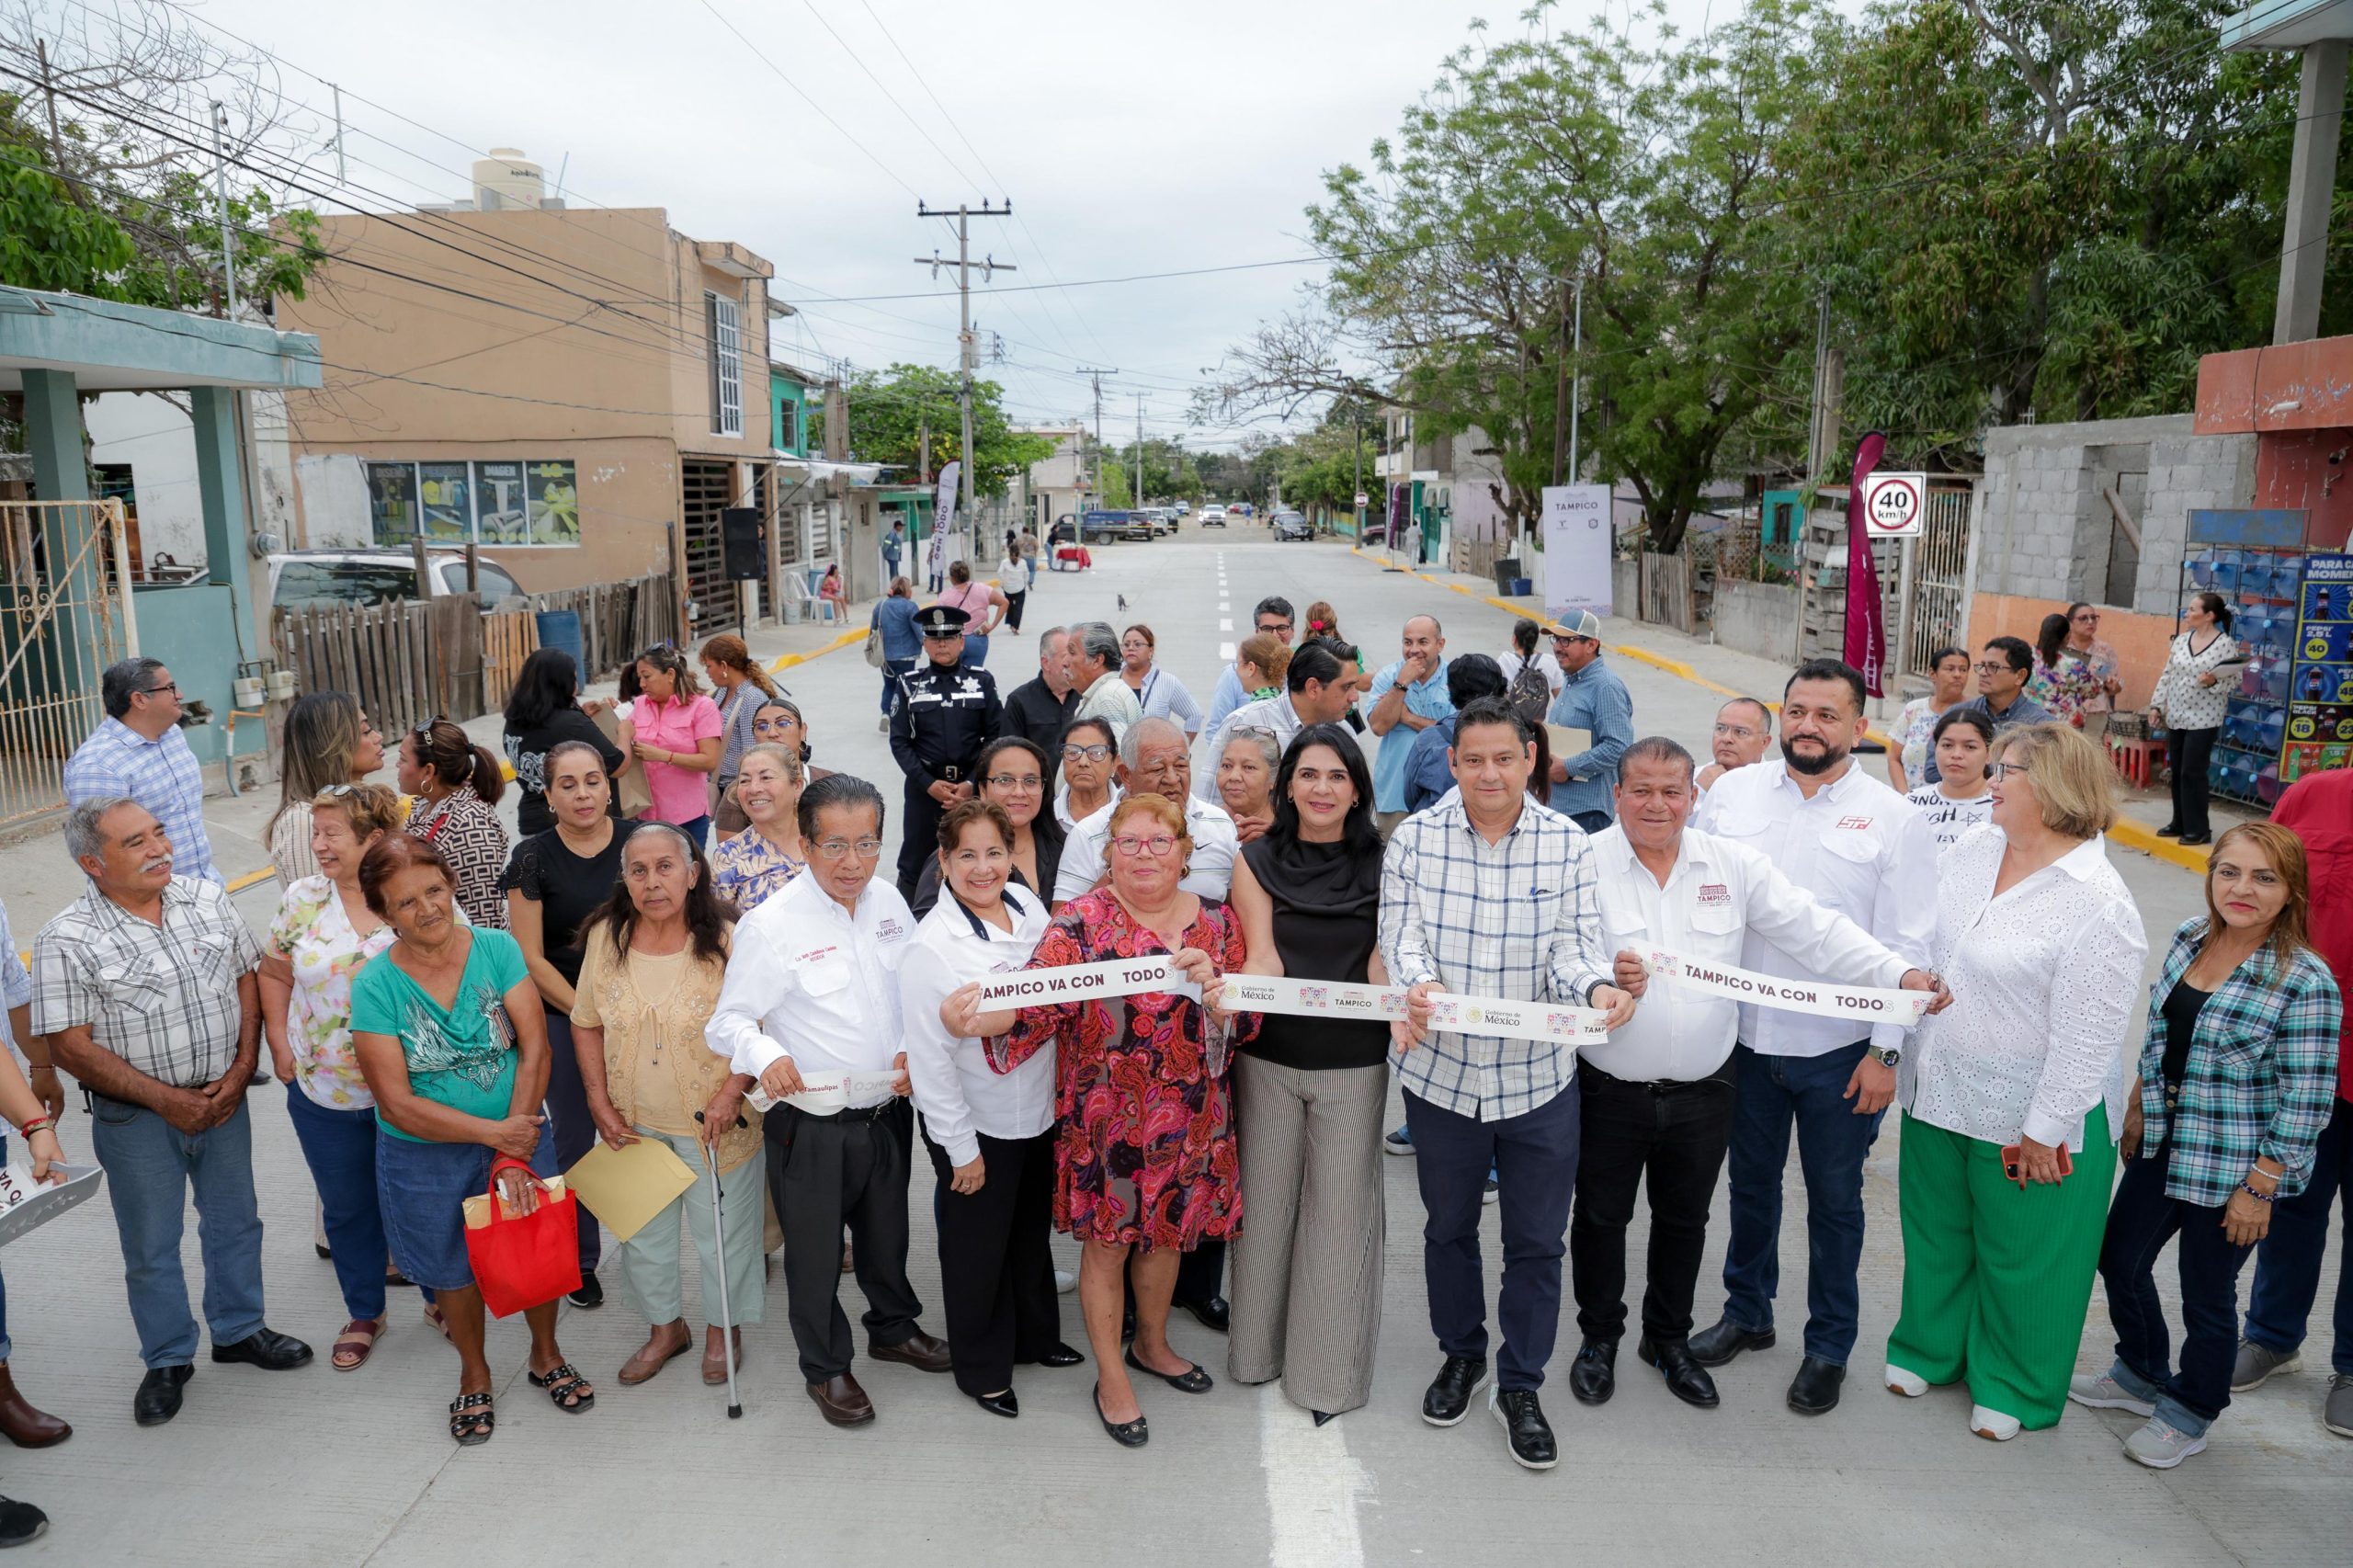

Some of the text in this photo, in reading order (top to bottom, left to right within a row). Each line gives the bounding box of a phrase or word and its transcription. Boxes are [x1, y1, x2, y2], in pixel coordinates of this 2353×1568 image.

[1879, 491, 1908, 508] 40
[1555, 502, 1598, 511] TAMPICO
[1878, 509, 1907, 519] km/h
[2312, 559, 2343, 570] PARA
[875, 926, 904, 939] TAMPICO
[981, 981, 1044, 1000] AMPICO
[1048, 978, 1067, 992] VA
[1071, 973, 1105, 987] CON
[1685, 964, 1753, 992] TAMPICO
[1756, 983, 1776, 997] VA
[1780, 988, 1817, 1004] CON
[1241, 990, 1275, 1001] México
[1335, 998, 1372, 1008] TAMPICO
[1484, 1009, 1513, 1017] Gobierno
[1484, 1015, 1520, 1026] México
[803, 1085, 838, 1093] Tamaulipas
